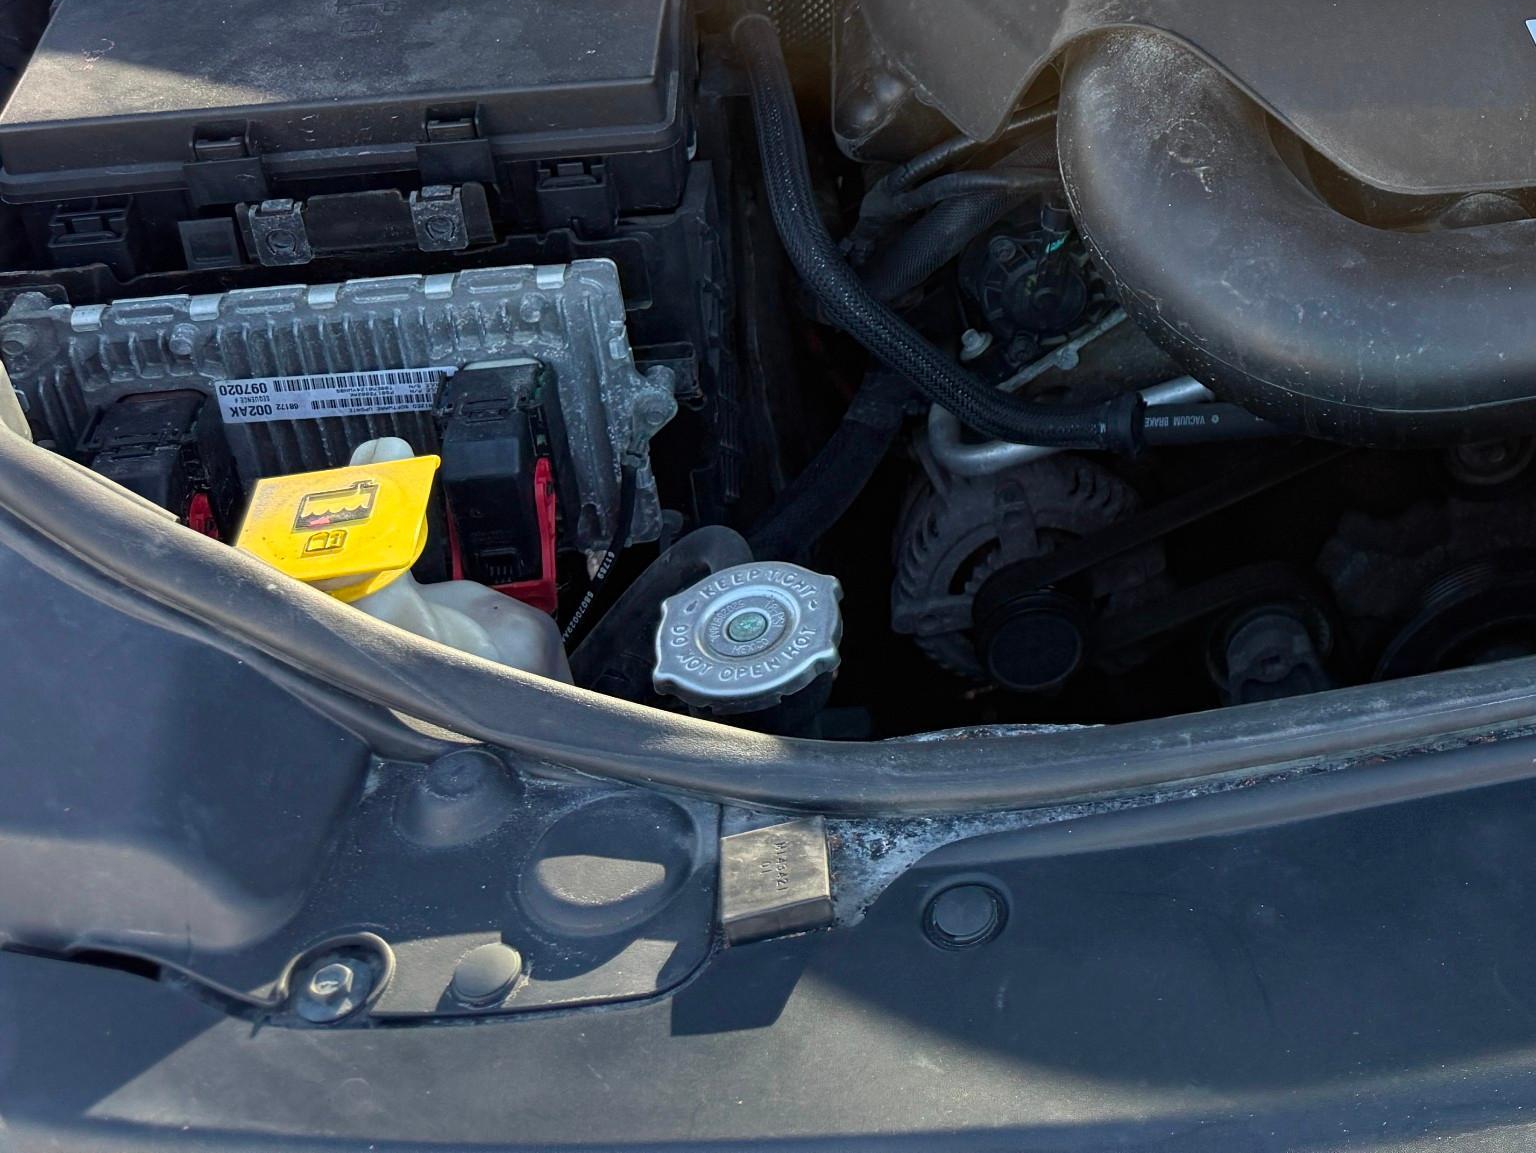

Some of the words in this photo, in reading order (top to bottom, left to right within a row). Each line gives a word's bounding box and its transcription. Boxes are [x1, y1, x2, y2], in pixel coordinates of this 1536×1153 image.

[219, 381, 267, 395] 097020
[231, 404, 272, 418] 002AK
[1144, 417, 1169, 428] BRAKE
[1173, 415, 1206, 426] VACUUM
[699, 569, 761, 599] KEEP
[676, 649, 713, 676] NOT
[719, 658, 783, 681] OPEN
[782, 626, 817, 661] HOT
